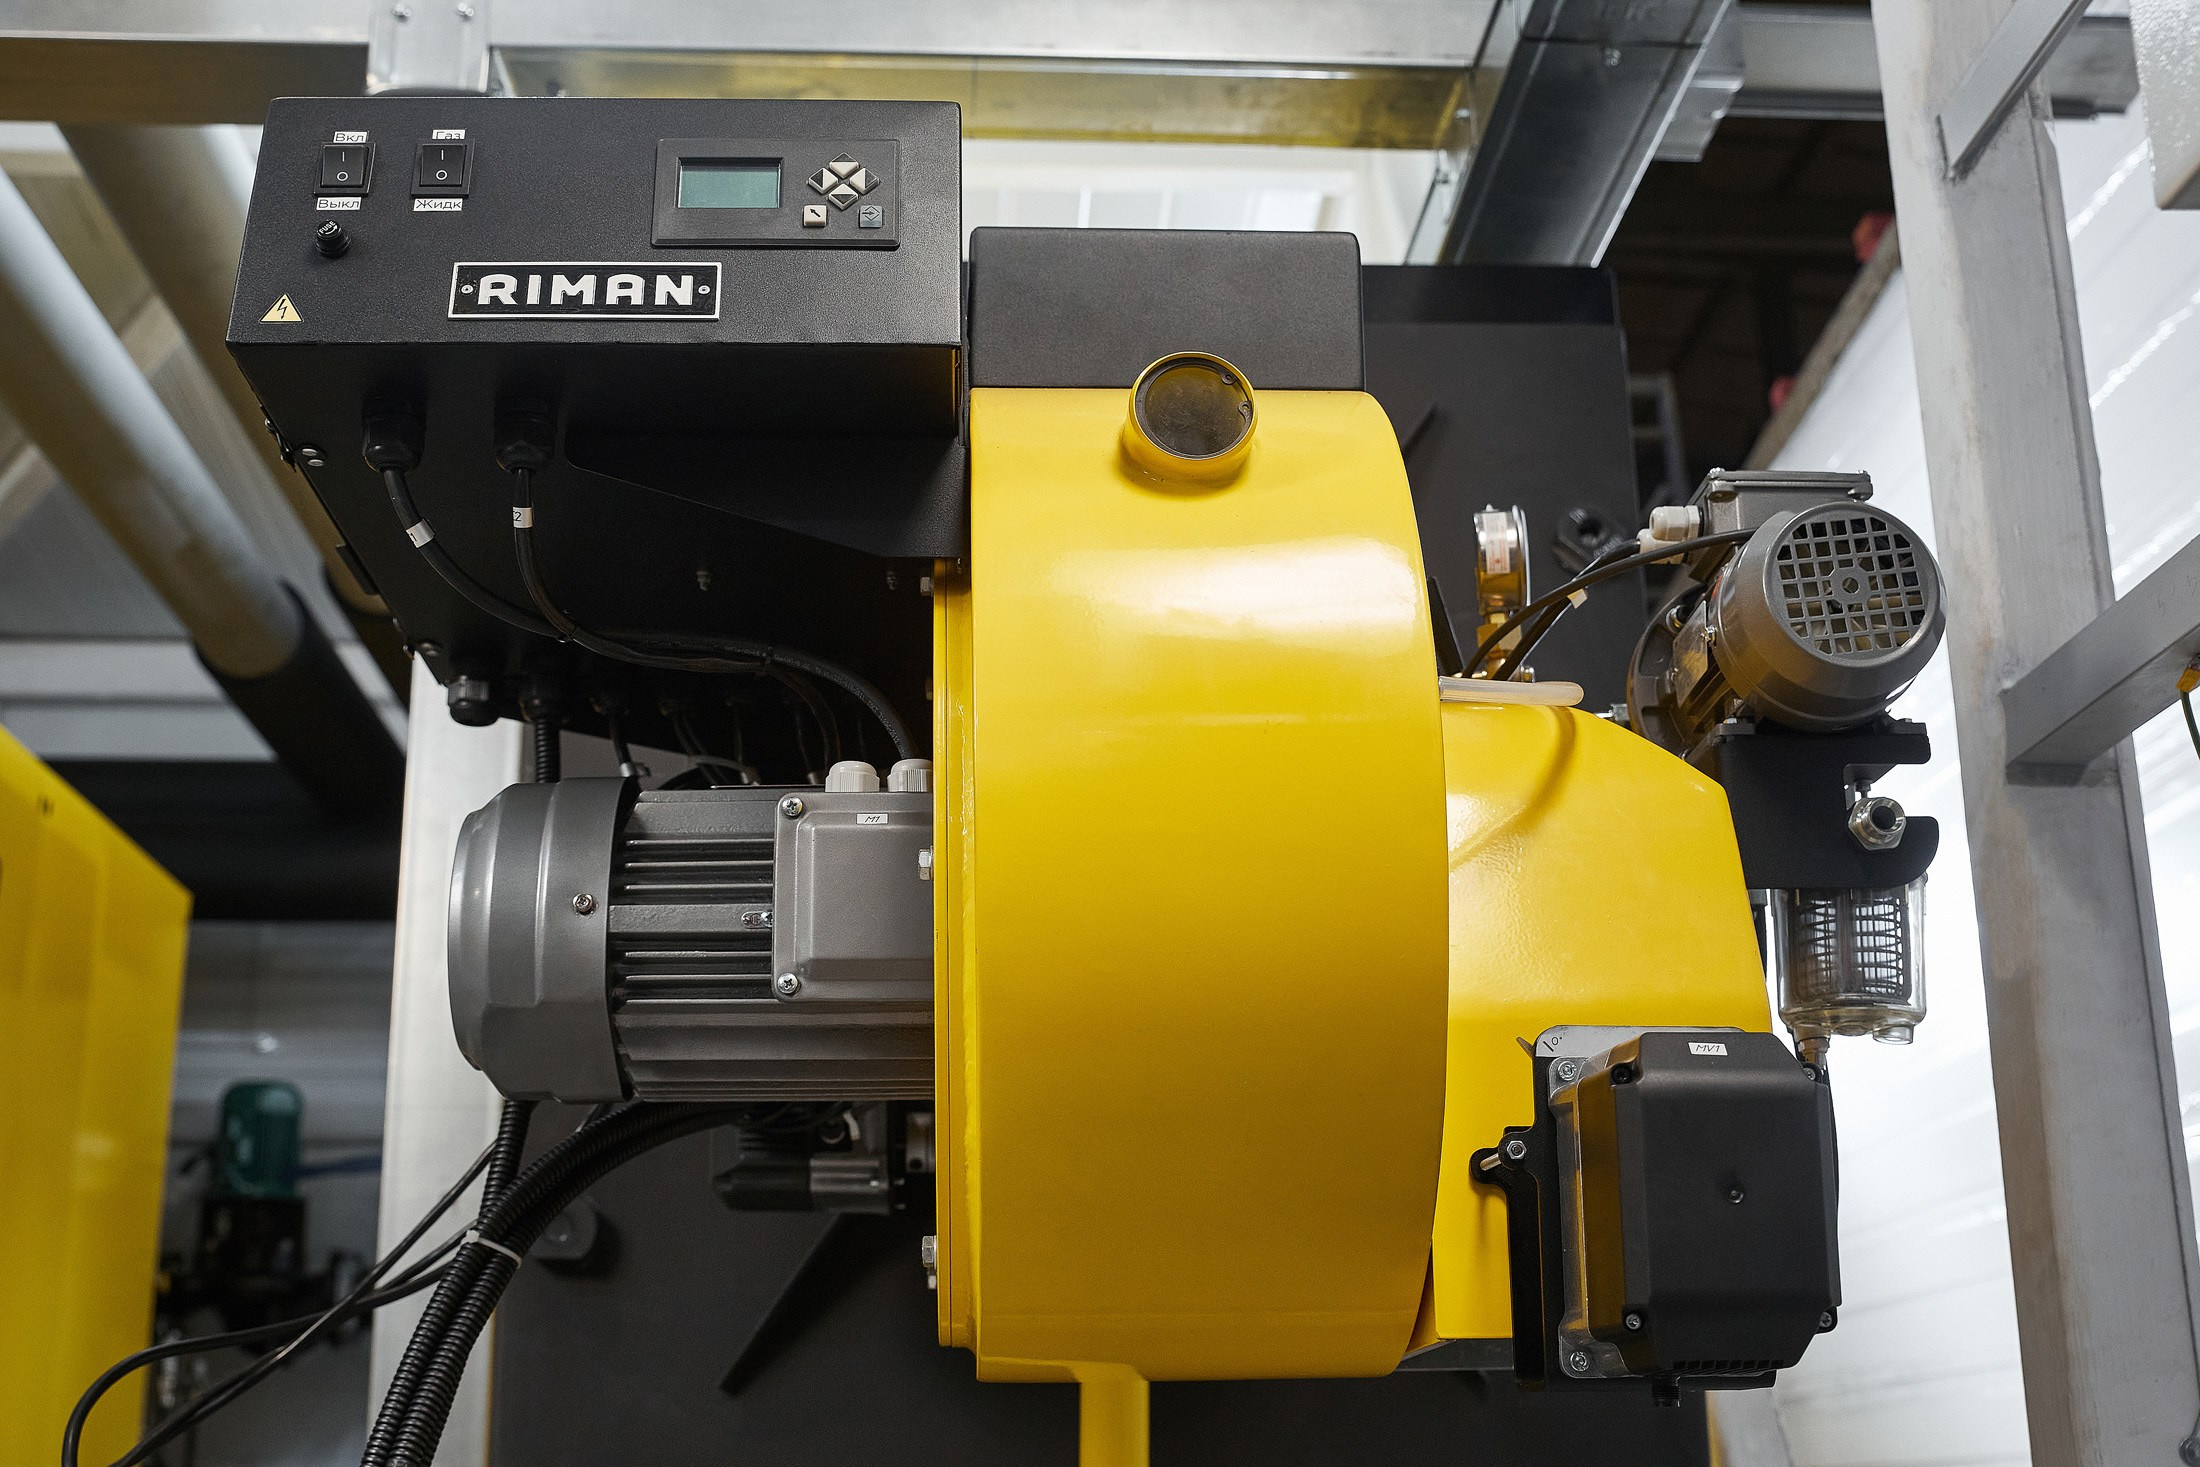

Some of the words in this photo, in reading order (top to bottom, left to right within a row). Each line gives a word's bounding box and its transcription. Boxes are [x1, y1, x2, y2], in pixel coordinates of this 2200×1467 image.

[336, 133, 363, 142] Вкл
[436, 131, 461, 139] Газ
[318, 199, 360, 208] Выкл
[416, 199, 461, 209] Жидк
[318, 220, 336, 234] FUSE
[477, 273, 694, 306] RIMAN
[1695, 1044, 1720, 1053] MV1
